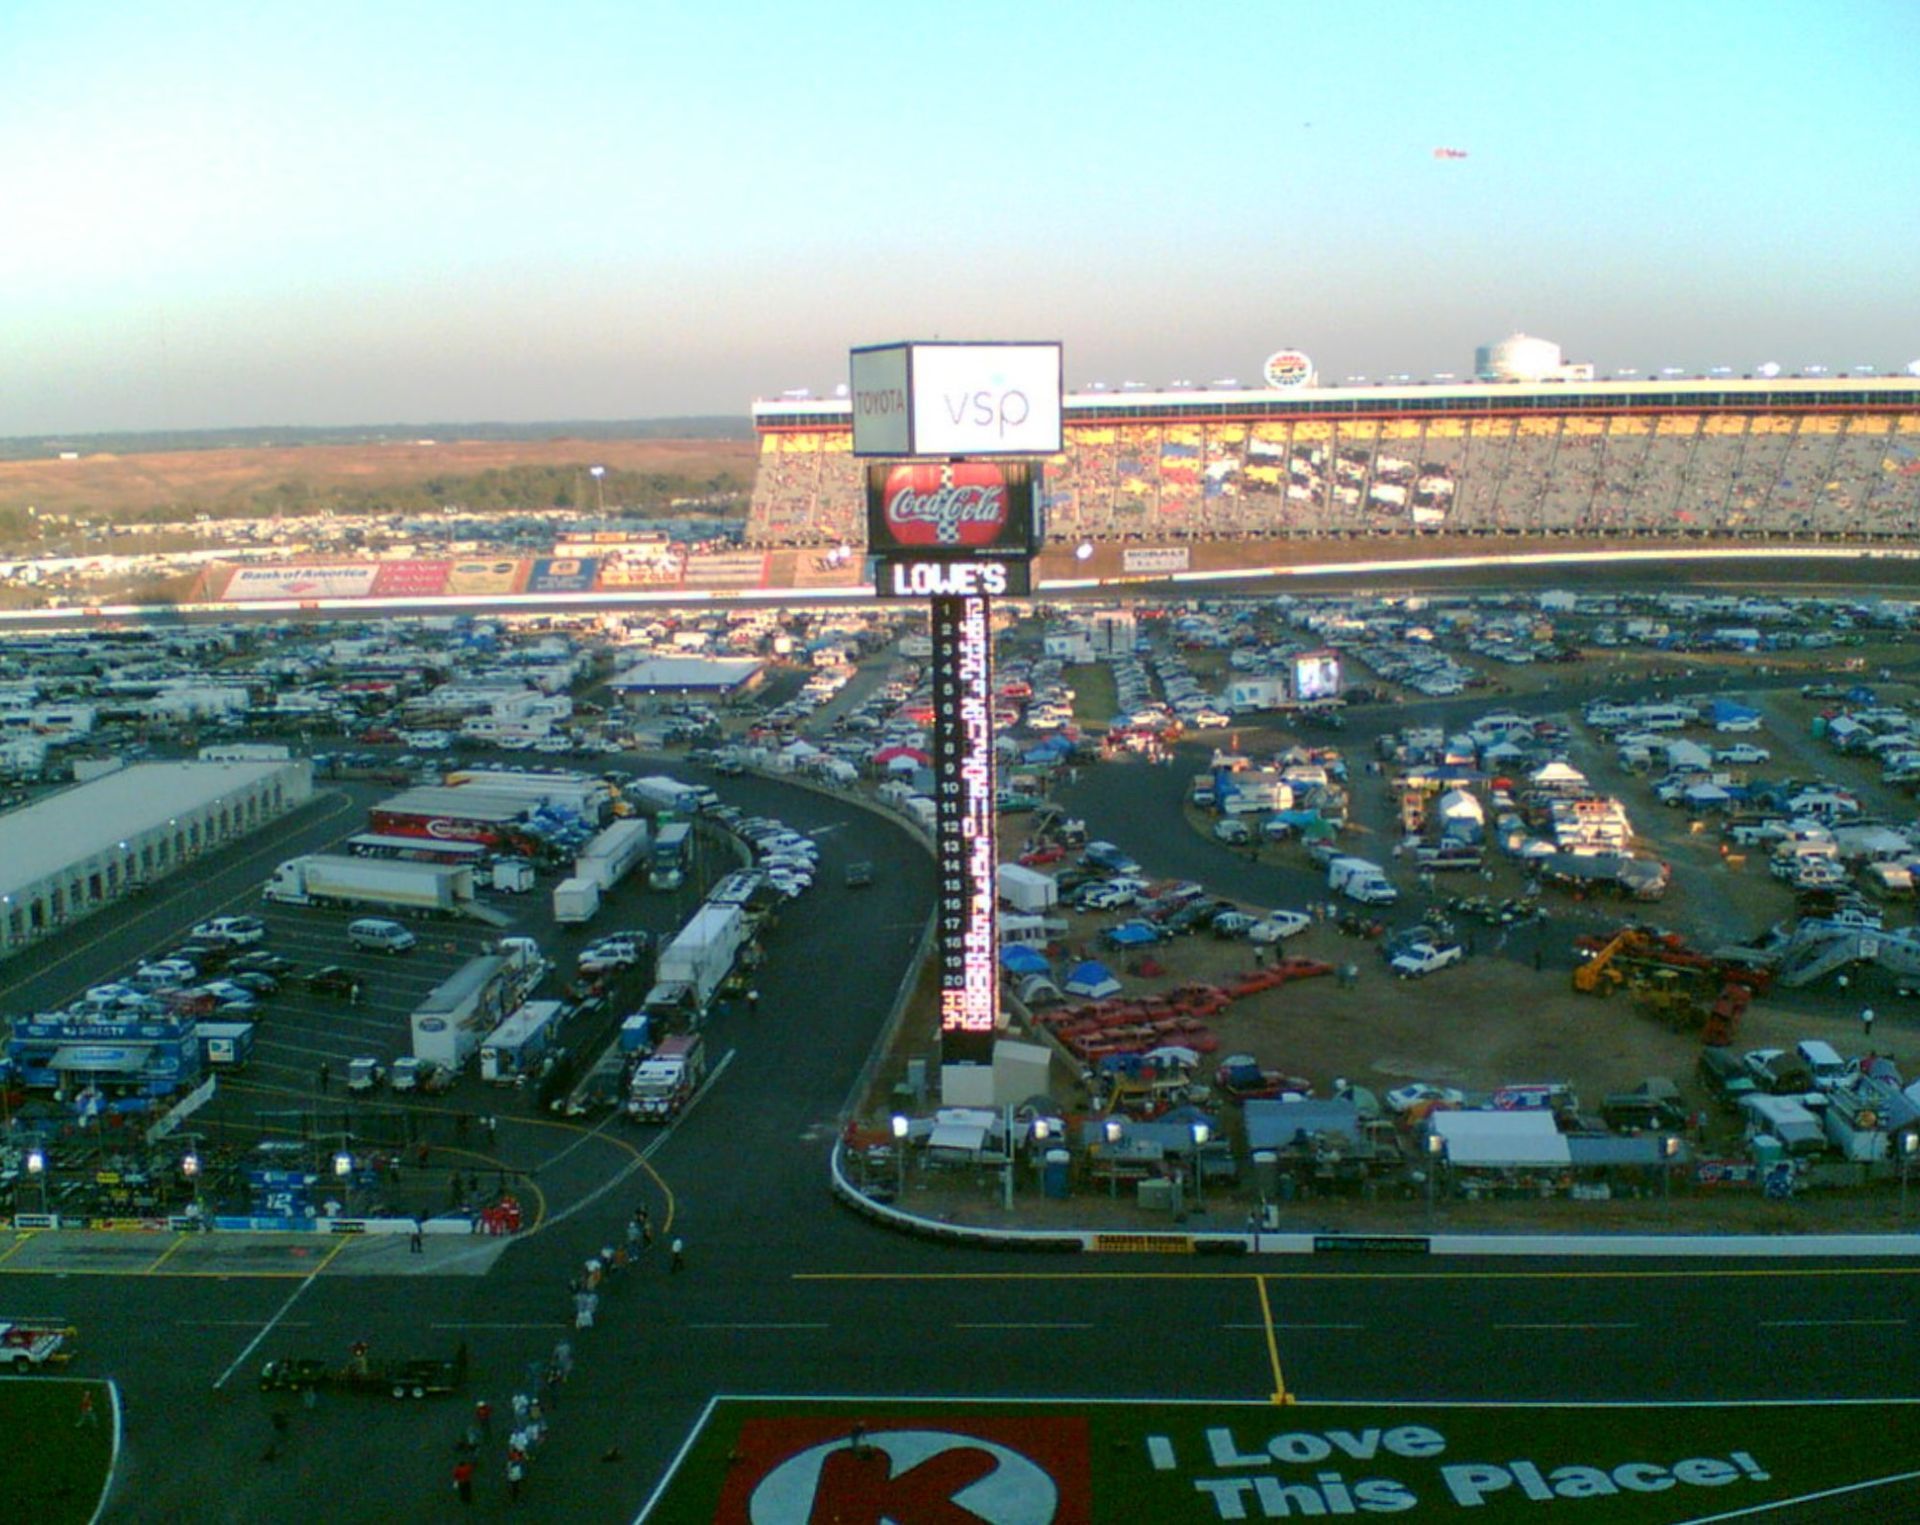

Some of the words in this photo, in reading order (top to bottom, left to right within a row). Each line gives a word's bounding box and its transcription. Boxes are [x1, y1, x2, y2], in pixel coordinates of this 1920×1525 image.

[857, 390, 904, 416] TOYOTA
[943, 391, 1029, 439] vsp
[241, 570, 281, 581] Bank
[283, 570, 301, 579] of
[302, 568, 368, 579] America
[894, 563, 1007, 595] LOWE'S
[942, 604, 950, 617] 1
[966, 598, 984, 618] 12
[941, 623, 952, 636] 2
[959, 618, 985, 639] 48
[942, 643, 953, 656] 3
[942, 663, 953, 675] 4
[942, 683, 953, 696] 5
[972, 680, 986, 698] 9
[943, 703, 953, 716] 6
[944, 723, 954, 736] 7
[943, 742, 955, 755] 8
[944, 762, 955, 775] 9
[942, 782, 960, 795] 10
[941, 801, 957, 814] 11
[942, 821, 960, 833] 12
[943, 840, 960, 852] 13
[943, 859, 960, 872] 14
[944, 878, 961, 891] 15
[944, 898, 961, 910] 16
[944, 917, 961, 930] 17
[945, 937, 961, 950] 18
[945, 957, 962, 969] 19
[944, 976, 964, 986] 20
[942, 990, 965, 1010] 33
[942, 1010, 965, 1030] 34
[1146, 1435, 1176, 1470] I
[1206, 1425, 1447, 1467] Love
[806, 1446, 1000, 1525] K
[1194, 1471, 1418, 1520] This
[1440, 1451, 1772, 1507] Place!
